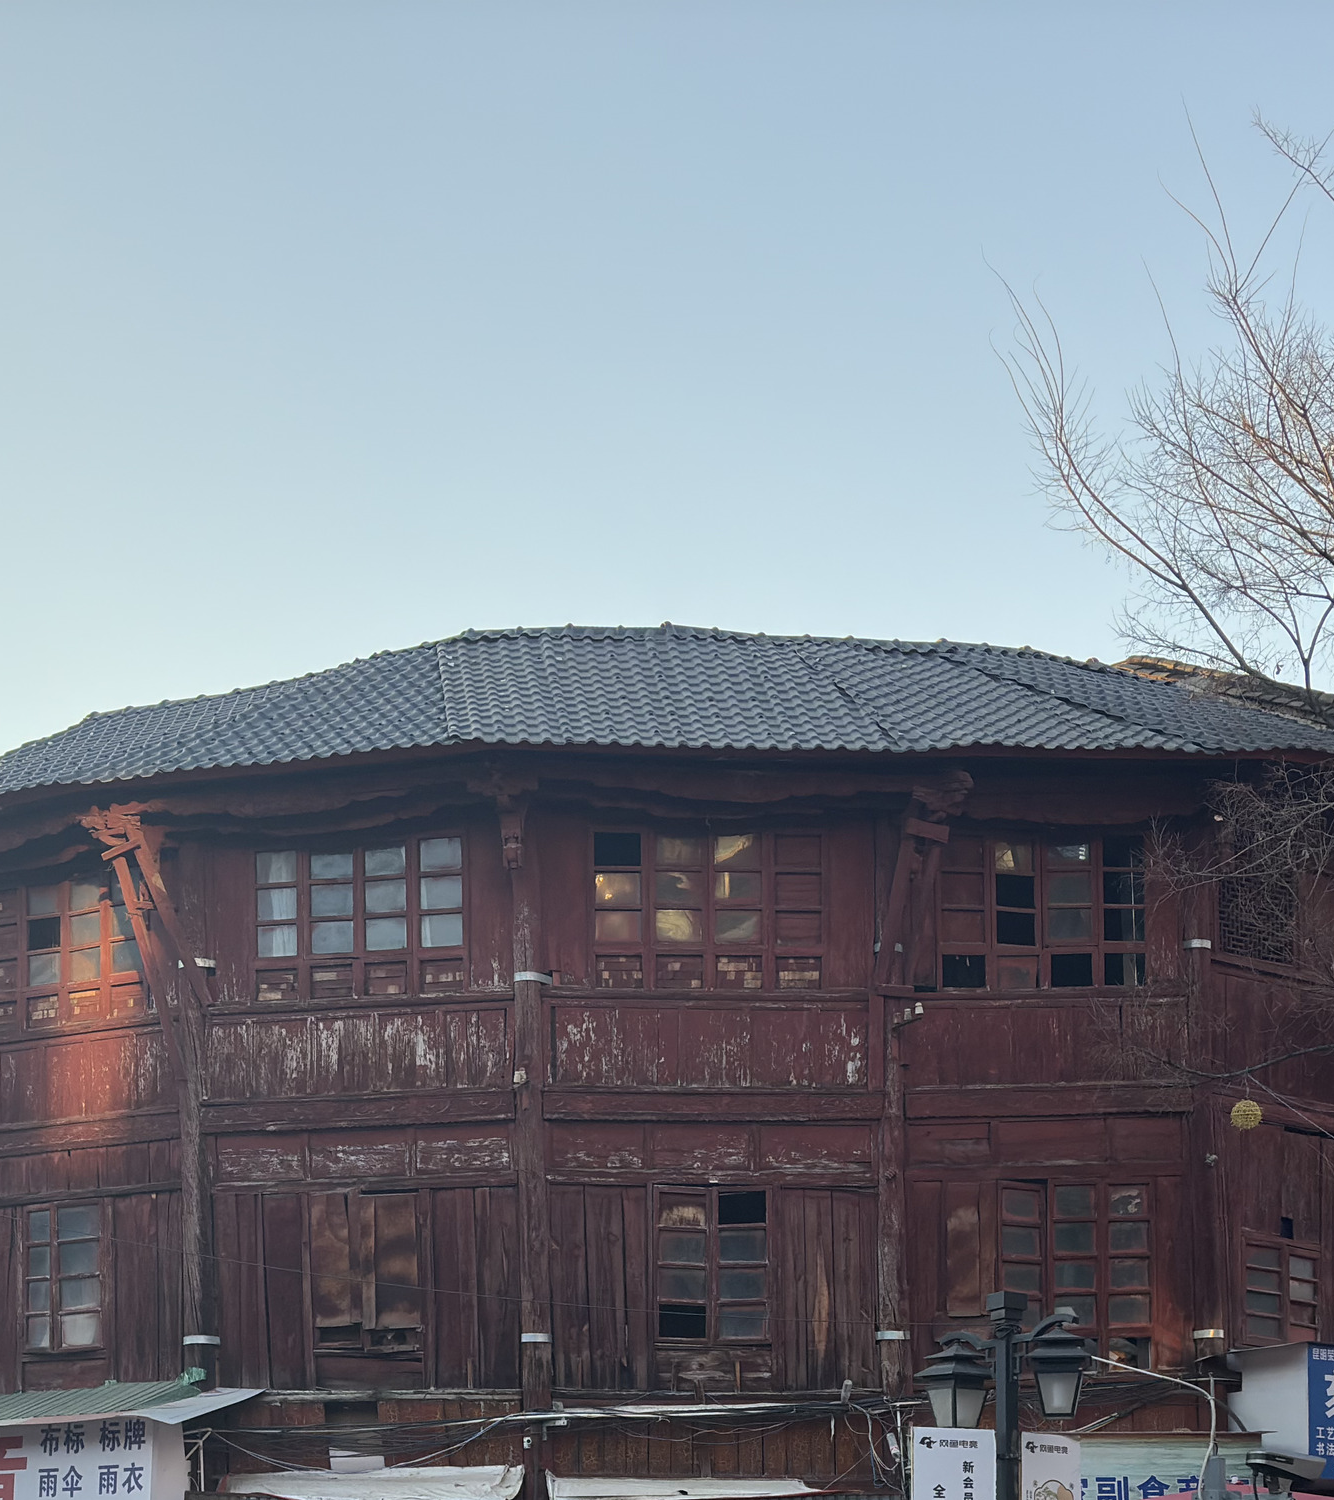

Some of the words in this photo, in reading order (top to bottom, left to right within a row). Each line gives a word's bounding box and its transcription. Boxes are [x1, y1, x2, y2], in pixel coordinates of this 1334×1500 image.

[40, 1423, 85, 1457] 布标
[99, 1419, 146, 1452] 标牌
[38, 1465, 83, 1498] 雨伞
[98, 1462, 145, 1495] 雨衣
